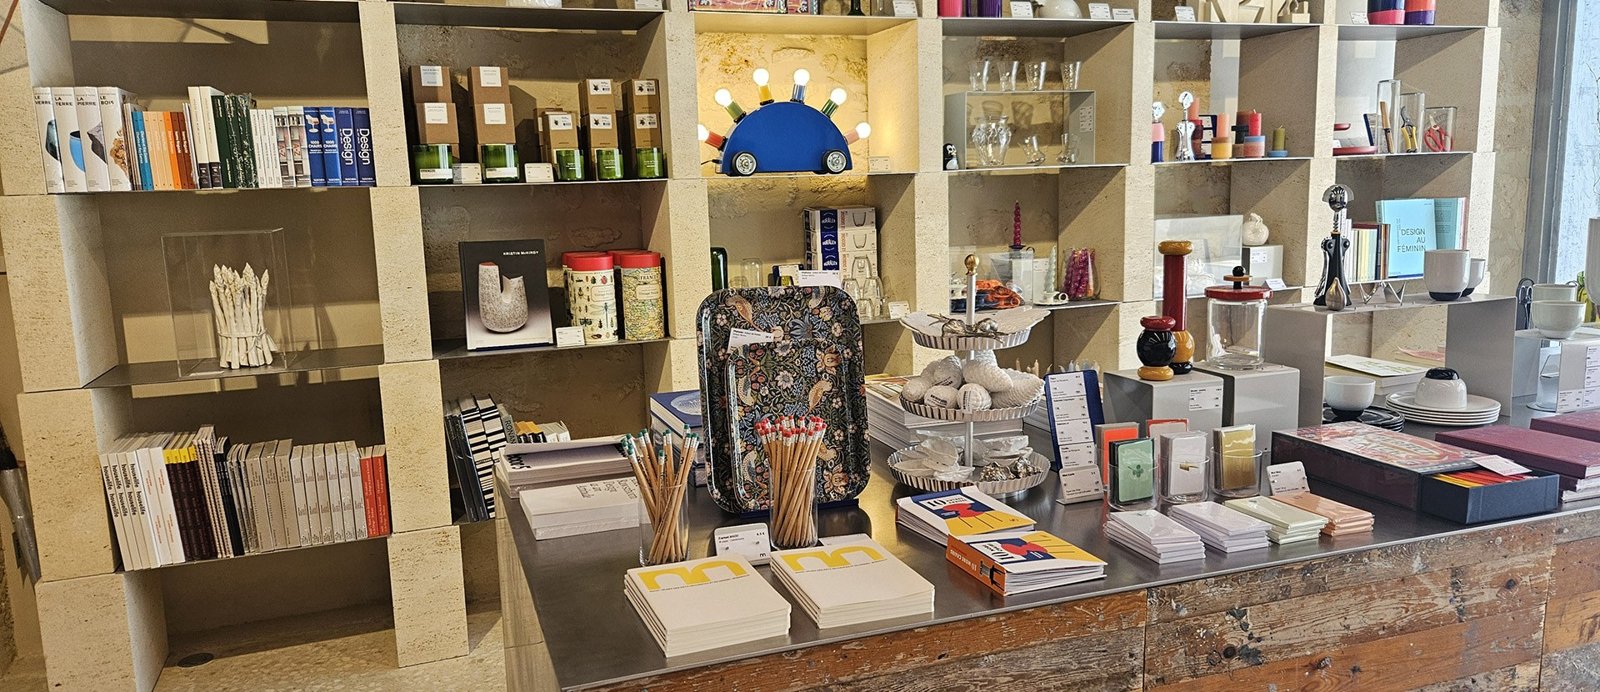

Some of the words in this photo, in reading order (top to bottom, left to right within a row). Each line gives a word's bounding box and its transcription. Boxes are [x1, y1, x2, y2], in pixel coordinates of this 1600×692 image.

[341, 128, 355, 165] Design
[358, 128, 372, 165] Design
[1401, 228, 1426, 236] DESIGN
[1397, 244, 1426, 253] FÉMININ
